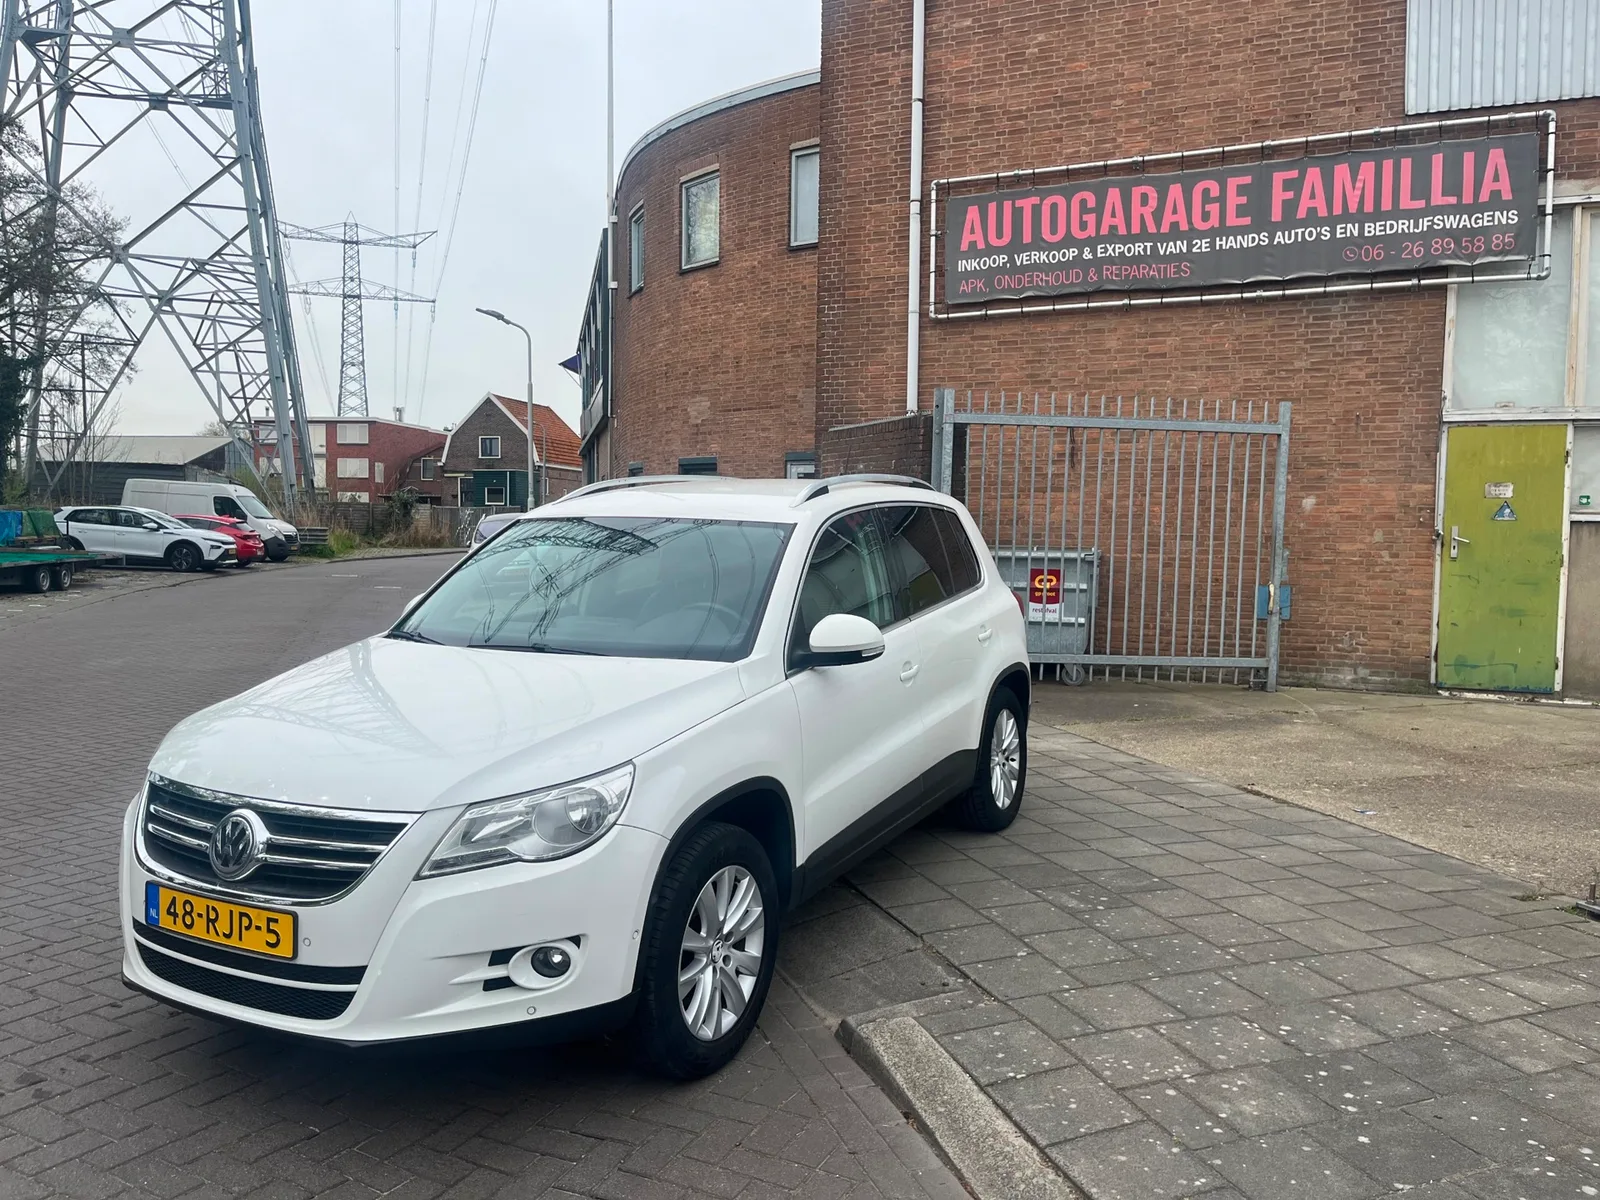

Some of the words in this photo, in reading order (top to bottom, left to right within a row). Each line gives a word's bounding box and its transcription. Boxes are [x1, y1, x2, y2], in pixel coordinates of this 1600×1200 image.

[960, 176, 1252, 252] AUTOGARAGE
[1271, 148, 1513, 222] FAMILLIA
[957, 254, 1010, 272] INKOOP,
[1014, 248, 1078, 267] VERKOOP
[1083, 247, 1093, 260] &
[1097, 242, 1154, 258] EXPORT
[1157, 240, 1187, 255] VAN
[1192, 238, 1211, 253] 2E
[1215, 231, 1269, 250] HANDS
[1273, 223, 1331, 245] AUTO'S
[1336, 222, 1359, 238] EN
[1364, 209, 1519, 237] BEDRIJFSWAGENS
[1361, 245, 1384, 262] 06
[1401, 241, 1424, 259] 26
[1430, 237, 1455, 256] 89
[1461, 235, 1485, 253] 58
[1491, 232, 1516, 251] 85
[959, 277, 989, 295] APK,
[994, 269, 1083, 289] ONDERHOUD
[1087, 268, 1099, 282] &
[1103, 262, 1191, 280] REPARATIES
[149, 907, 159, 919] NL
[166, 896, 281, 949] 48-RJP-5
